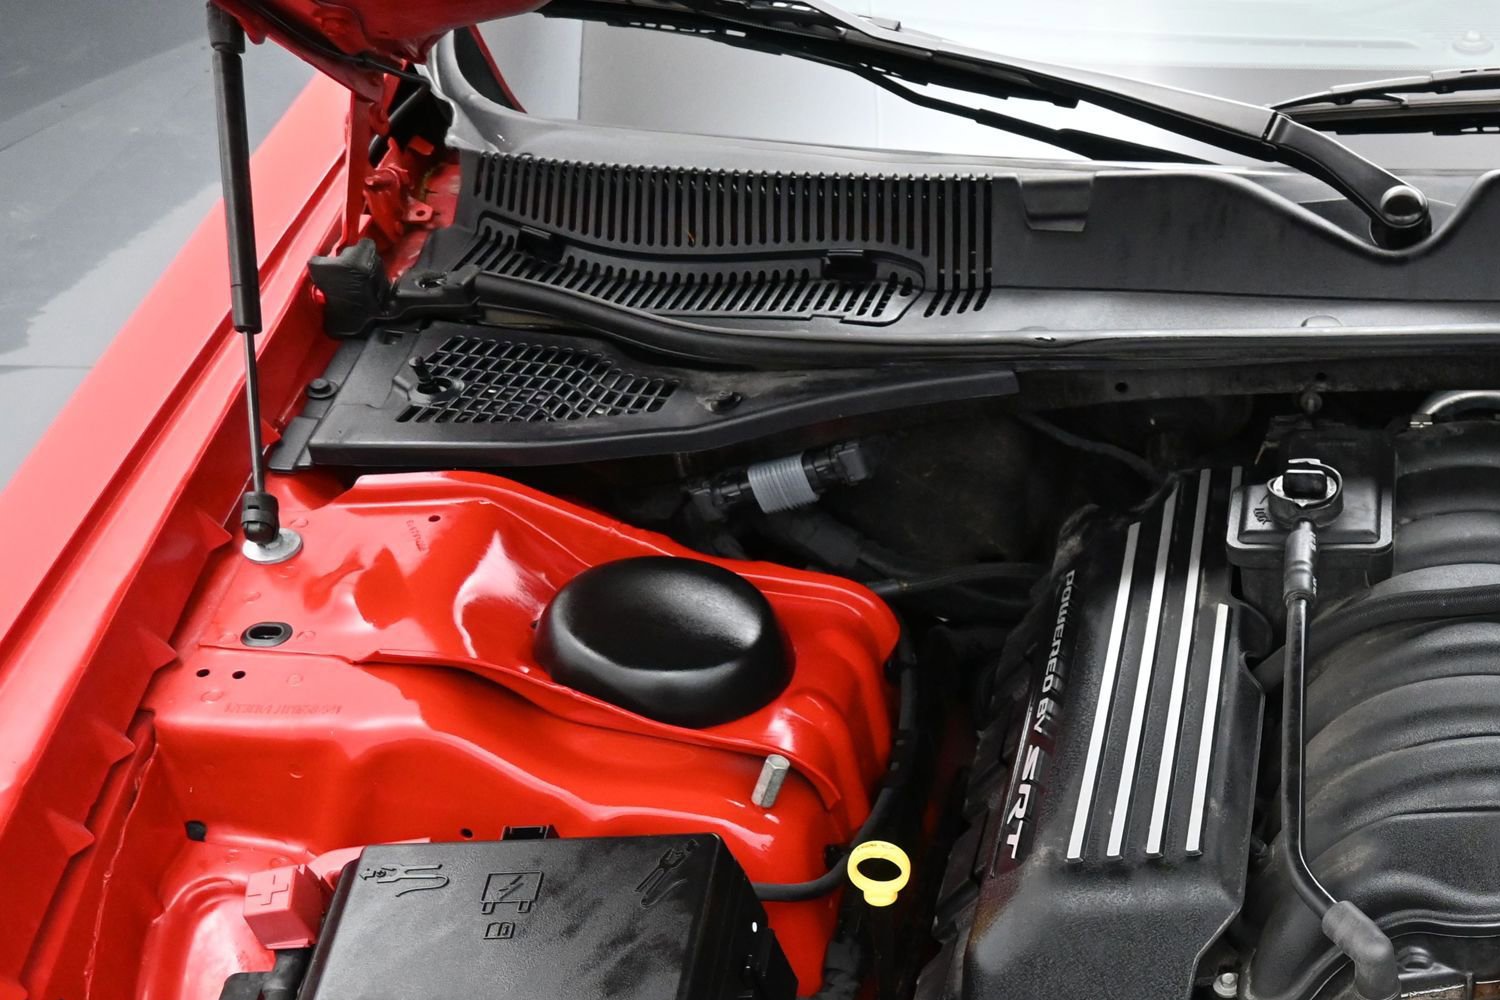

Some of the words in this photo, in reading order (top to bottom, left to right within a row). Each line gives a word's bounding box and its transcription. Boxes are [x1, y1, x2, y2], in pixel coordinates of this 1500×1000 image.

[1042, 569, 1075, 693] POWERED
[1033, 697, 1050, 734] BY
[1006, 744, 1040, 859] SRT
